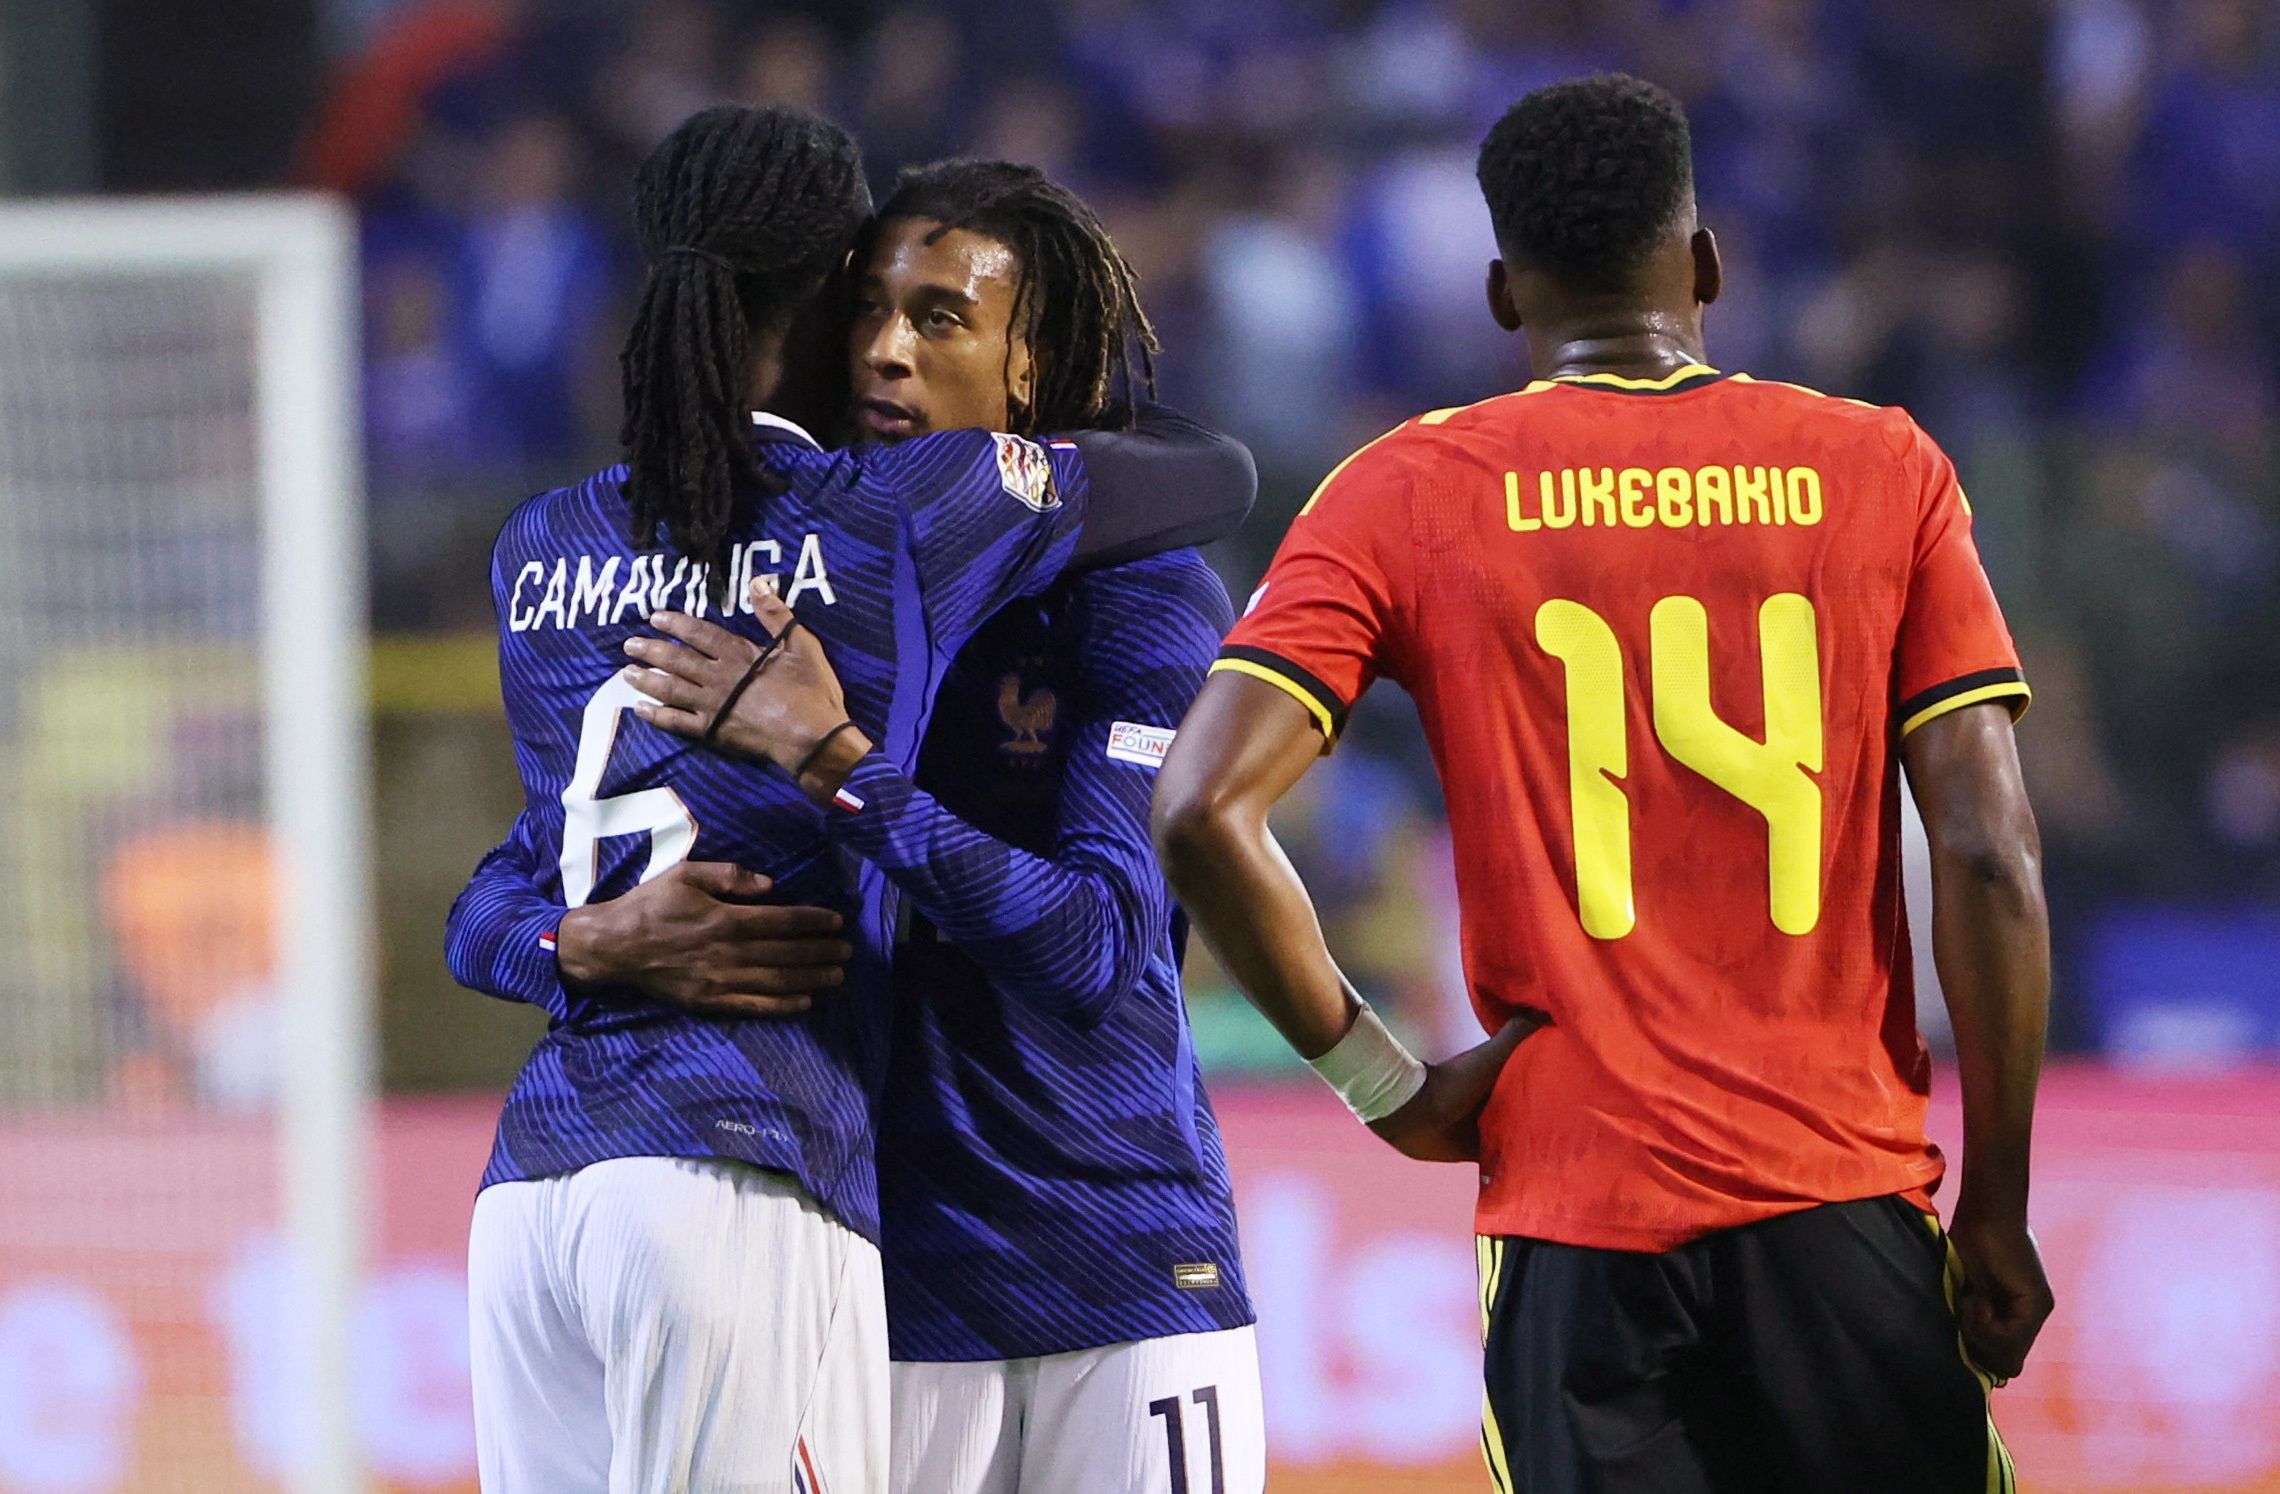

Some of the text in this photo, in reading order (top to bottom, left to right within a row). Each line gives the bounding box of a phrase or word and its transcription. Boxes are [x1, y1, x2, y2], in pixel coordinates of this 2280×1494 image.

[1505, 465, 1823, 532] LUKEBAKIO
[559, 667, 699, 909] 6
[1111, 733, 1165, 754] FOUN
[1534, 592, 1823, 939] 14
[1149, 1384, 1225, 1494] 11
